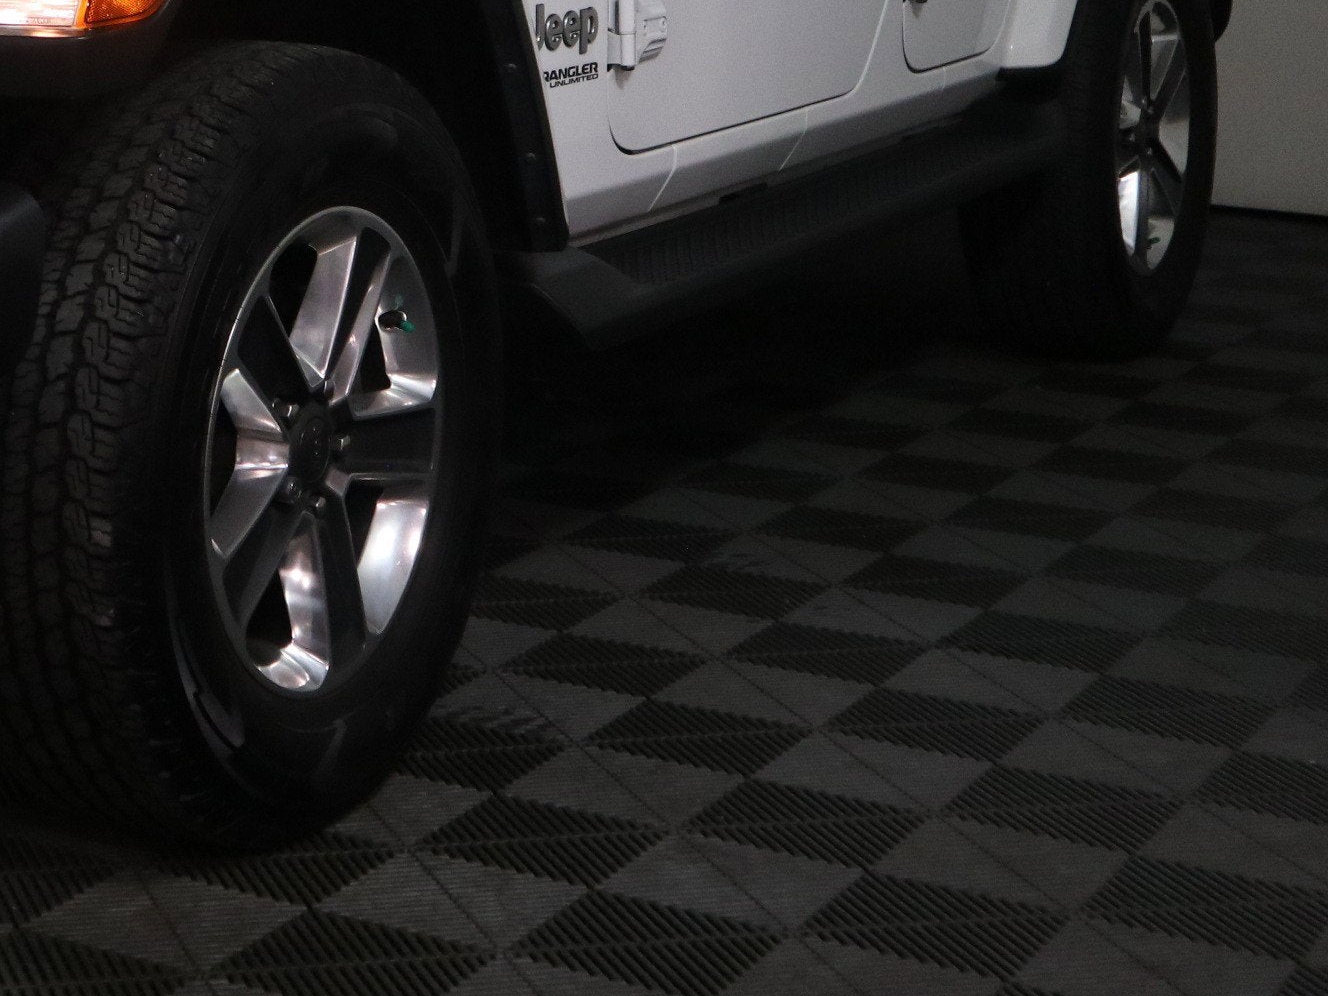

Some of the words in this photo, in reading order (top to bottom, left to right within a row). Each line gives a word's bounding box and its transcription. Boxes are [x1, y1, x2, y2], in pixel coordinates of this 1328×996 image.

[535, 3, 599, 55] Jeep
[543, 61, 598, 82] RANGLER
[549, 73, 599, 89] UNLIMITED
